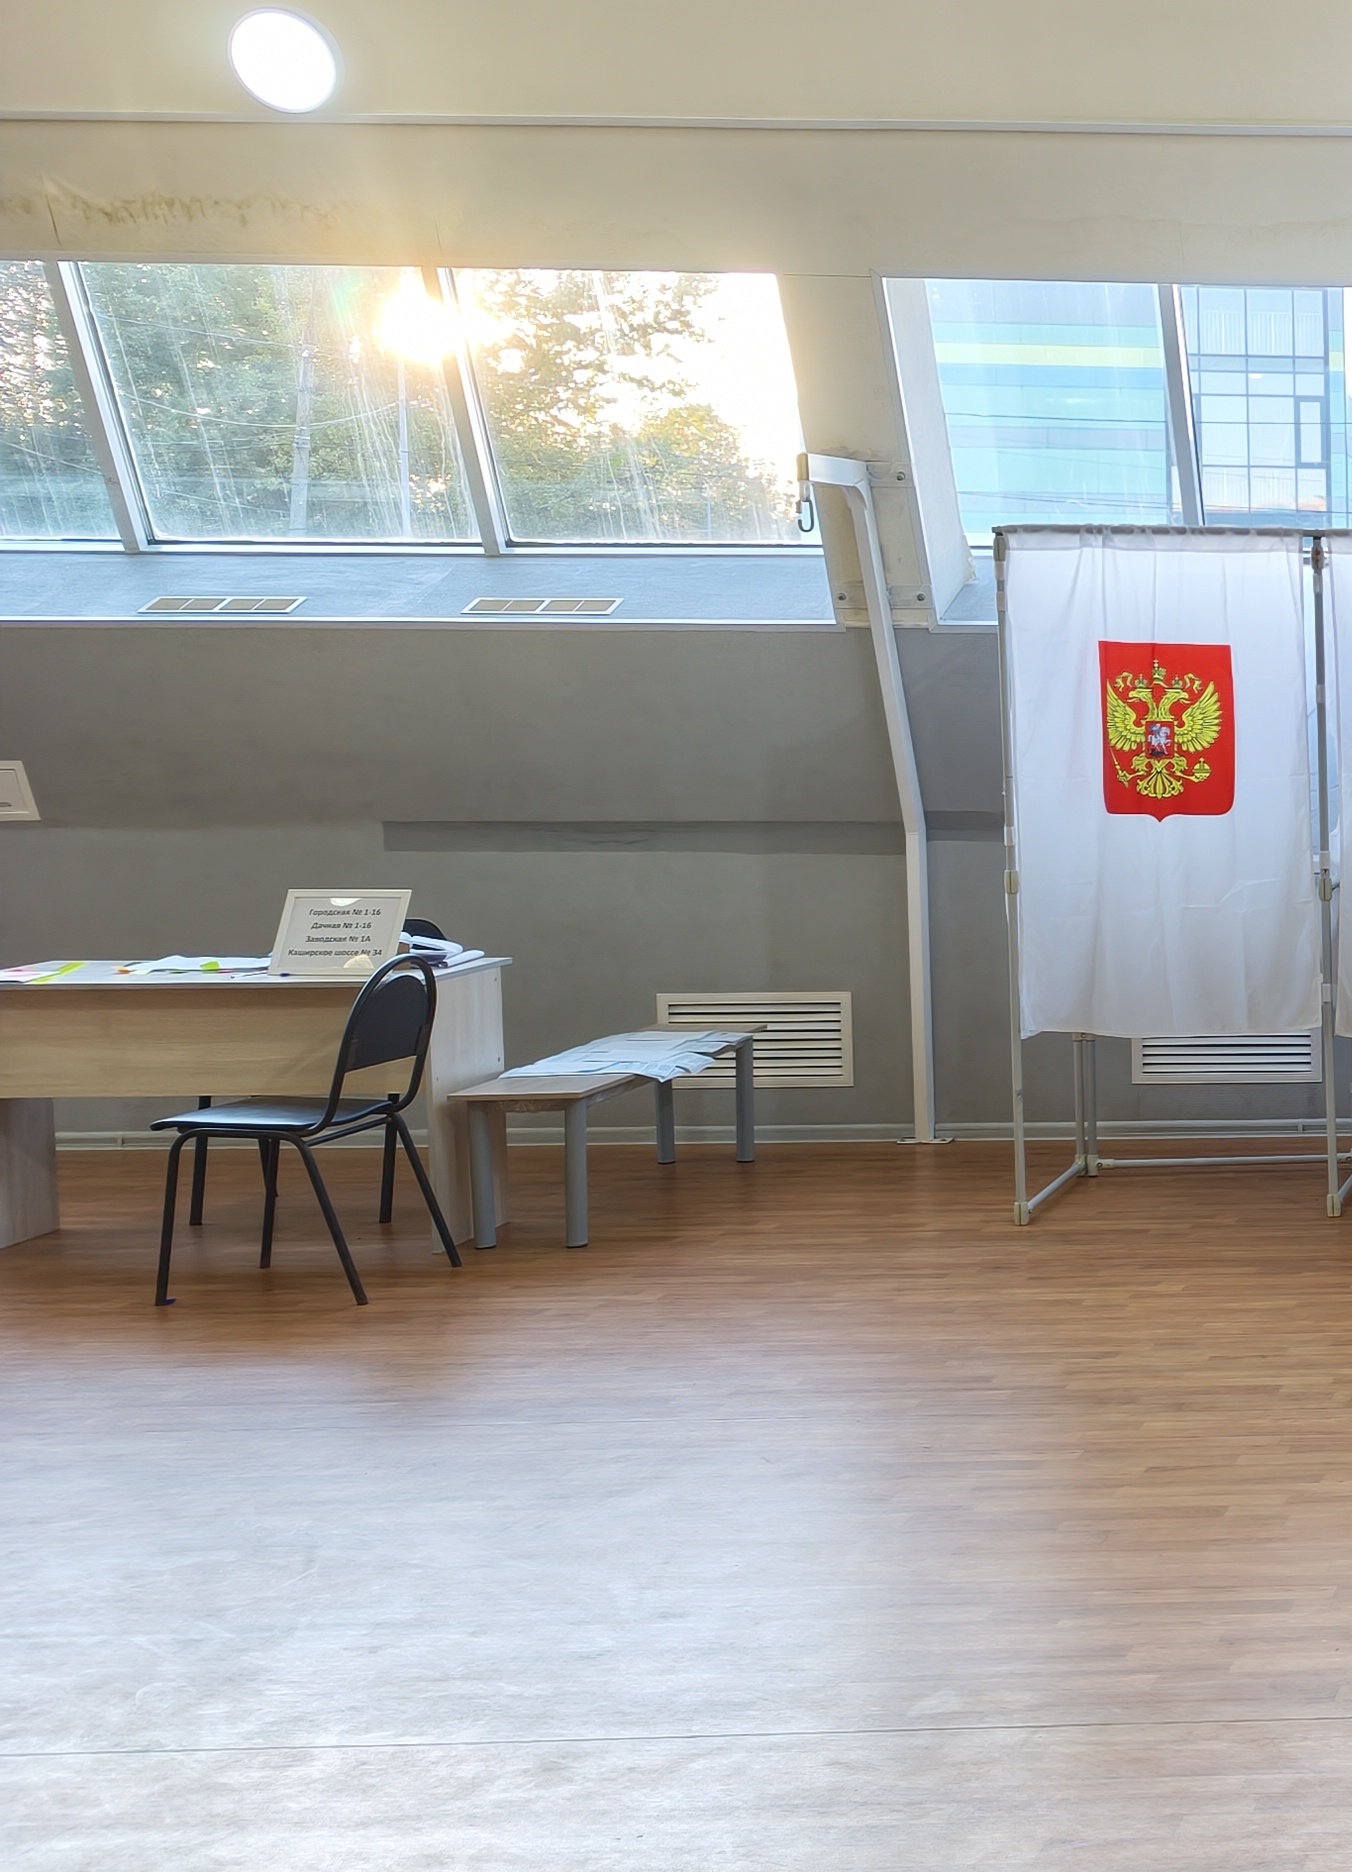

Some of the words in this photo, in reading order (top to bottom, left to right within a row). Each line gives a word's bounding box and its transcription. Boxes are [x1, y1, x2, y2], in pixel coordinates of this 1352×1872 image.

[309, 908, 351, 917] Городская
[364, 908, 382, 916] 1-16
[311, 922, 341, 930] Дачная
[305, 935, 347, 943] Заводская
[288, 949, 333, 957] Каширское
